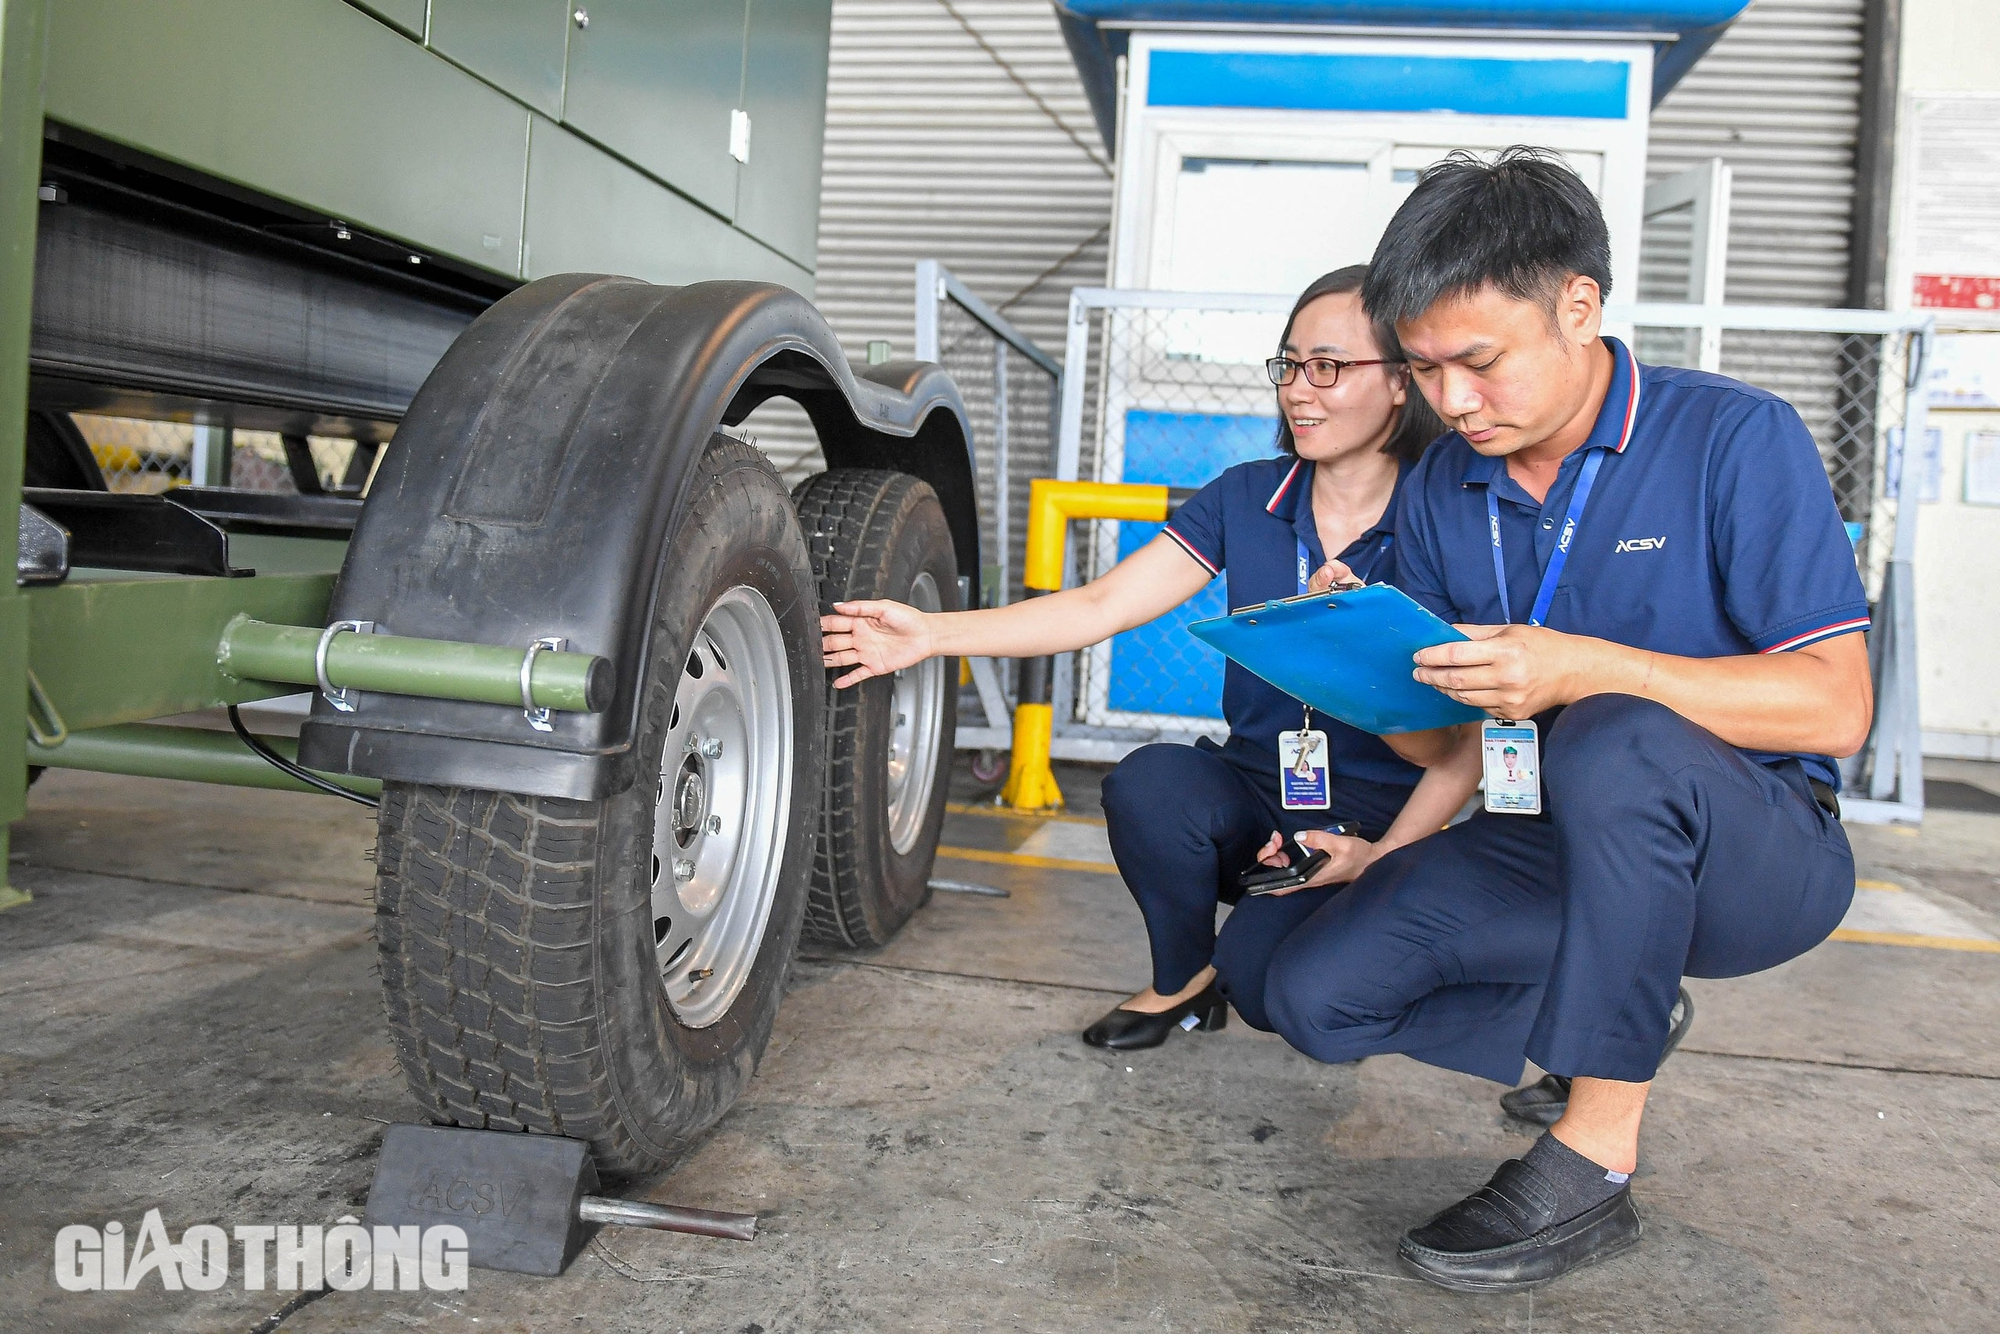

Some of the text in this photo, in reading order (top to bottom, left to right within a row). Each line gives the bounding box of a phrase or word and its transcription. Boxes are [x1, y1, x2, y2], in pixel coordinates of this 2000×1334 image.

[1490, 515, 1501, 548] ACSV
[1557, 517, 1576, 553] ACSV
[1614, 536, 1667, 553] ACSV
[1299, 556, 1307, 585] ACSV
[416, 1173, 528, 1218] ACSV
